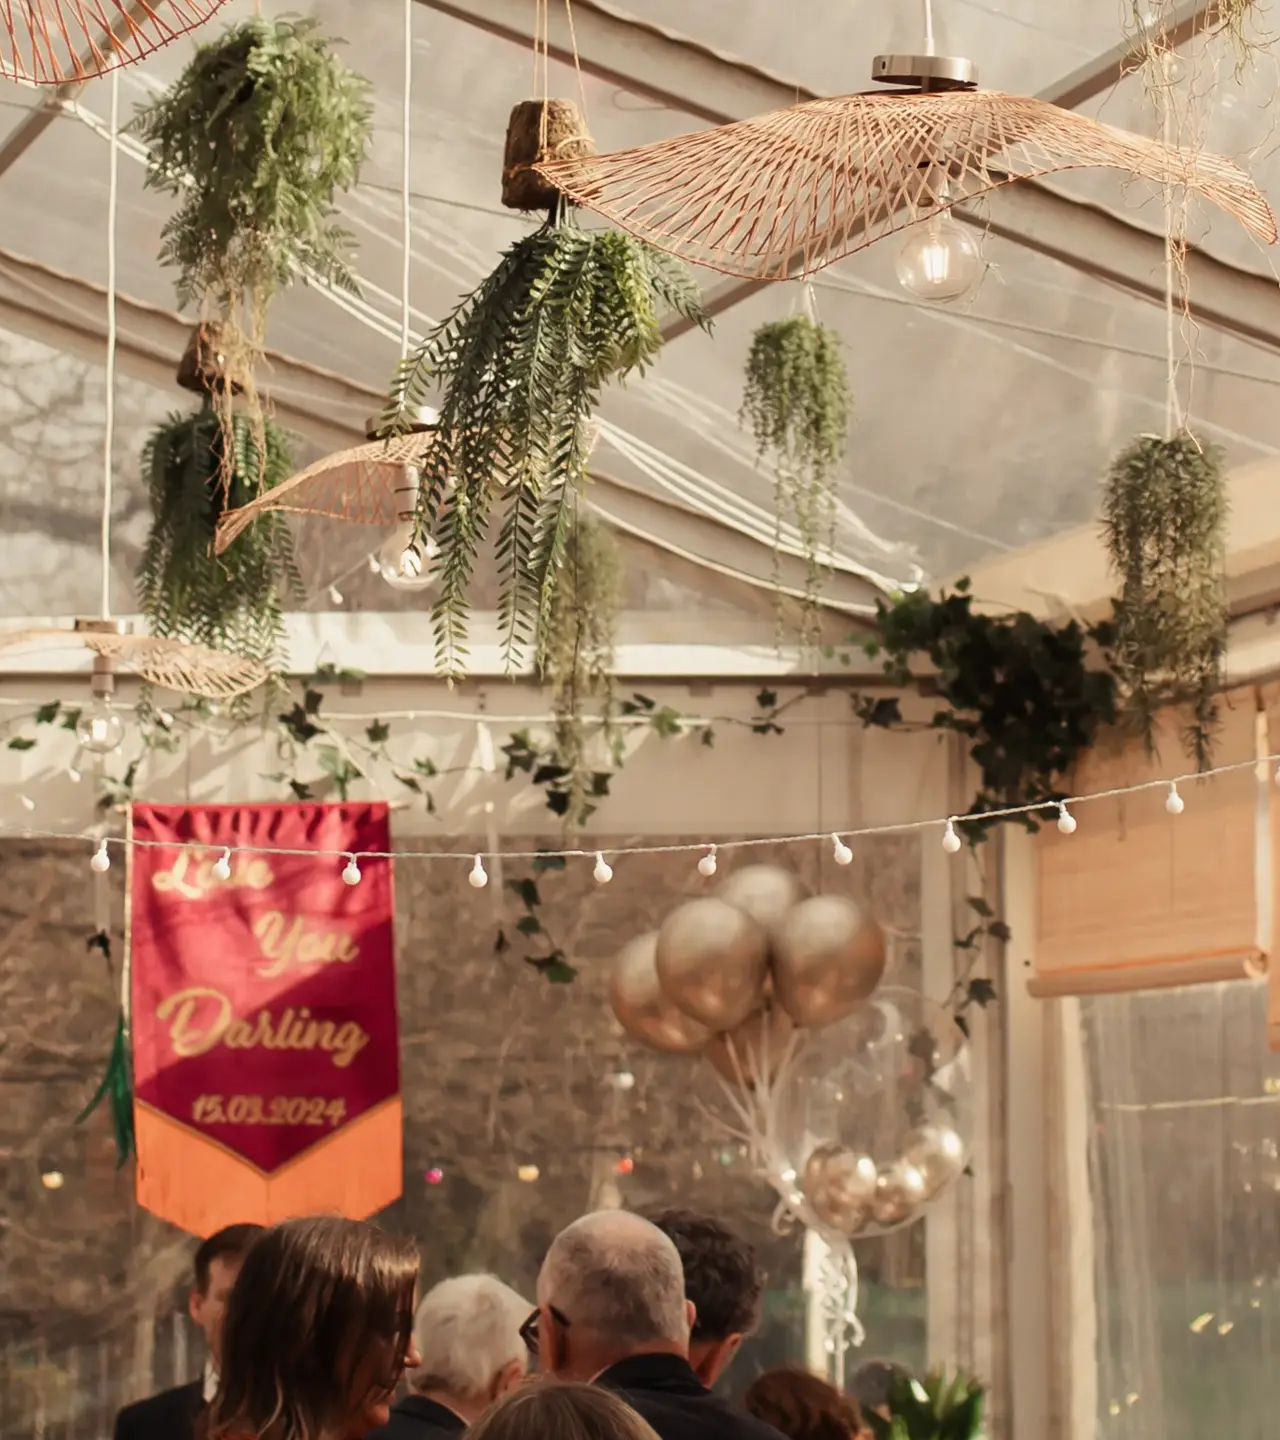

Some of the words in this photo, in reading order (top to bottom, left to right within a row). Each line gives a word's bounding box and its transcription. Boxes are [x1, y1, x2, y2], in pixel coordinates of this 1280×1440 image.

[253, 910, 360, 978] You
[156, 986, 369, 1068] Darling
[192, 1093, 346, 1127] 15.03.2024
